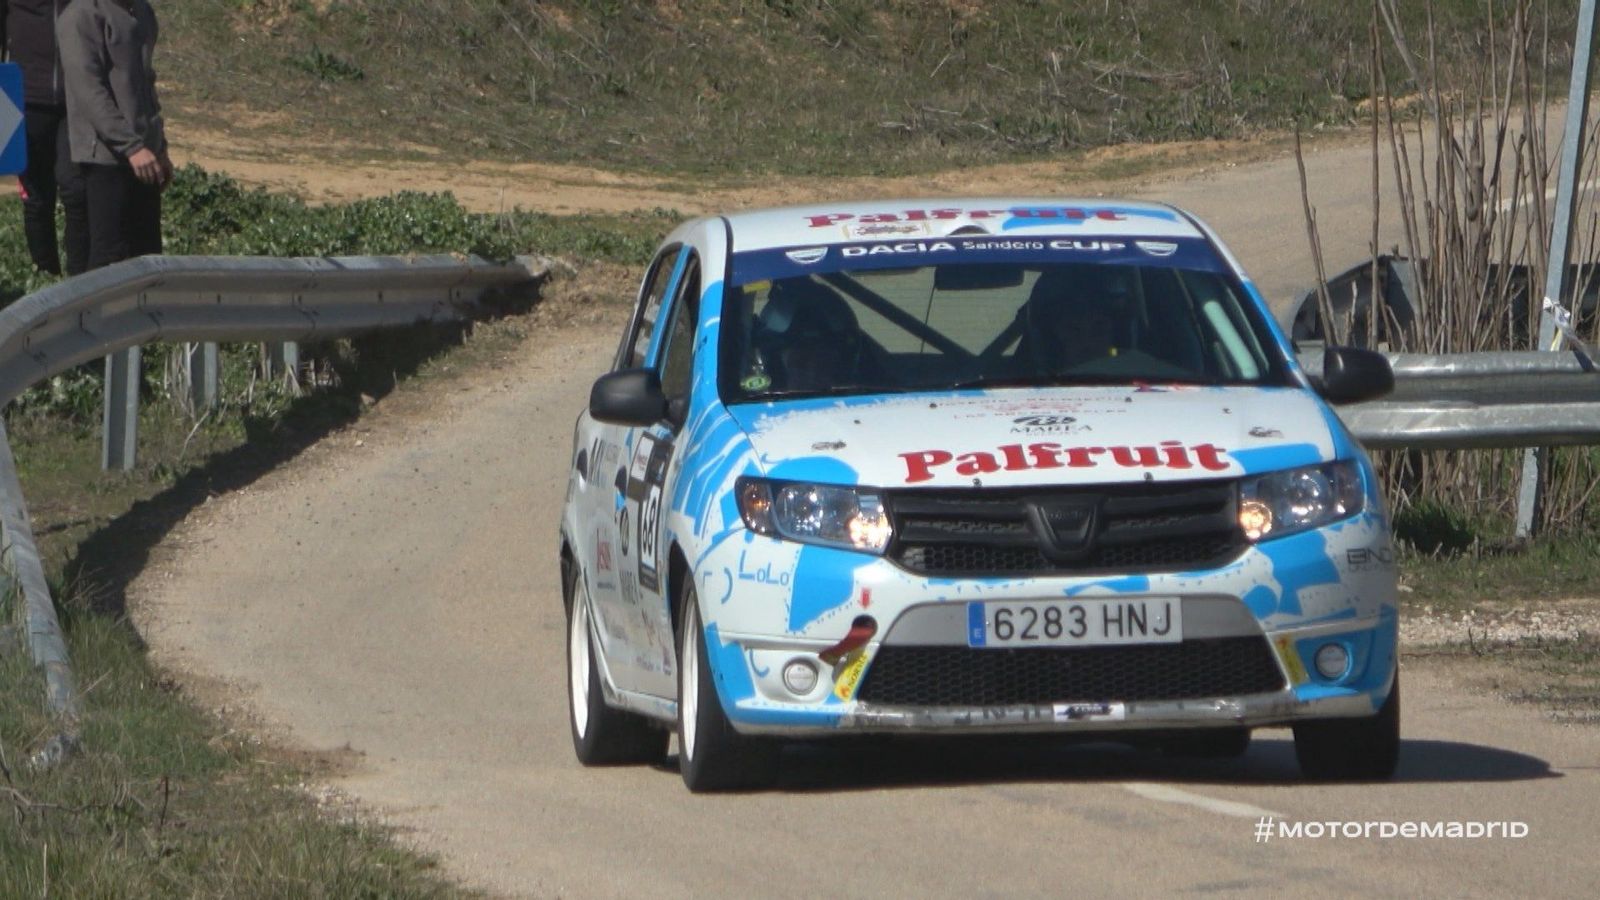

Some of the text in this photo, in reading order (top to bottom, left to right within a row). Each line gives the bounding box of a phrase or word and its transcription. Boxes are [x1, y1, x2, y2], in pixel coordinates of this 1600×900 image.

[805, 208, 1127, 227] Palfruit
[842, 239, 1126, 257] DACIA Sandero CUP
[897, 440, 1231, 483] Palfruit
[994, 604, 1088, 641] 6283
[1102, 602, 1172, 638] HNJ
